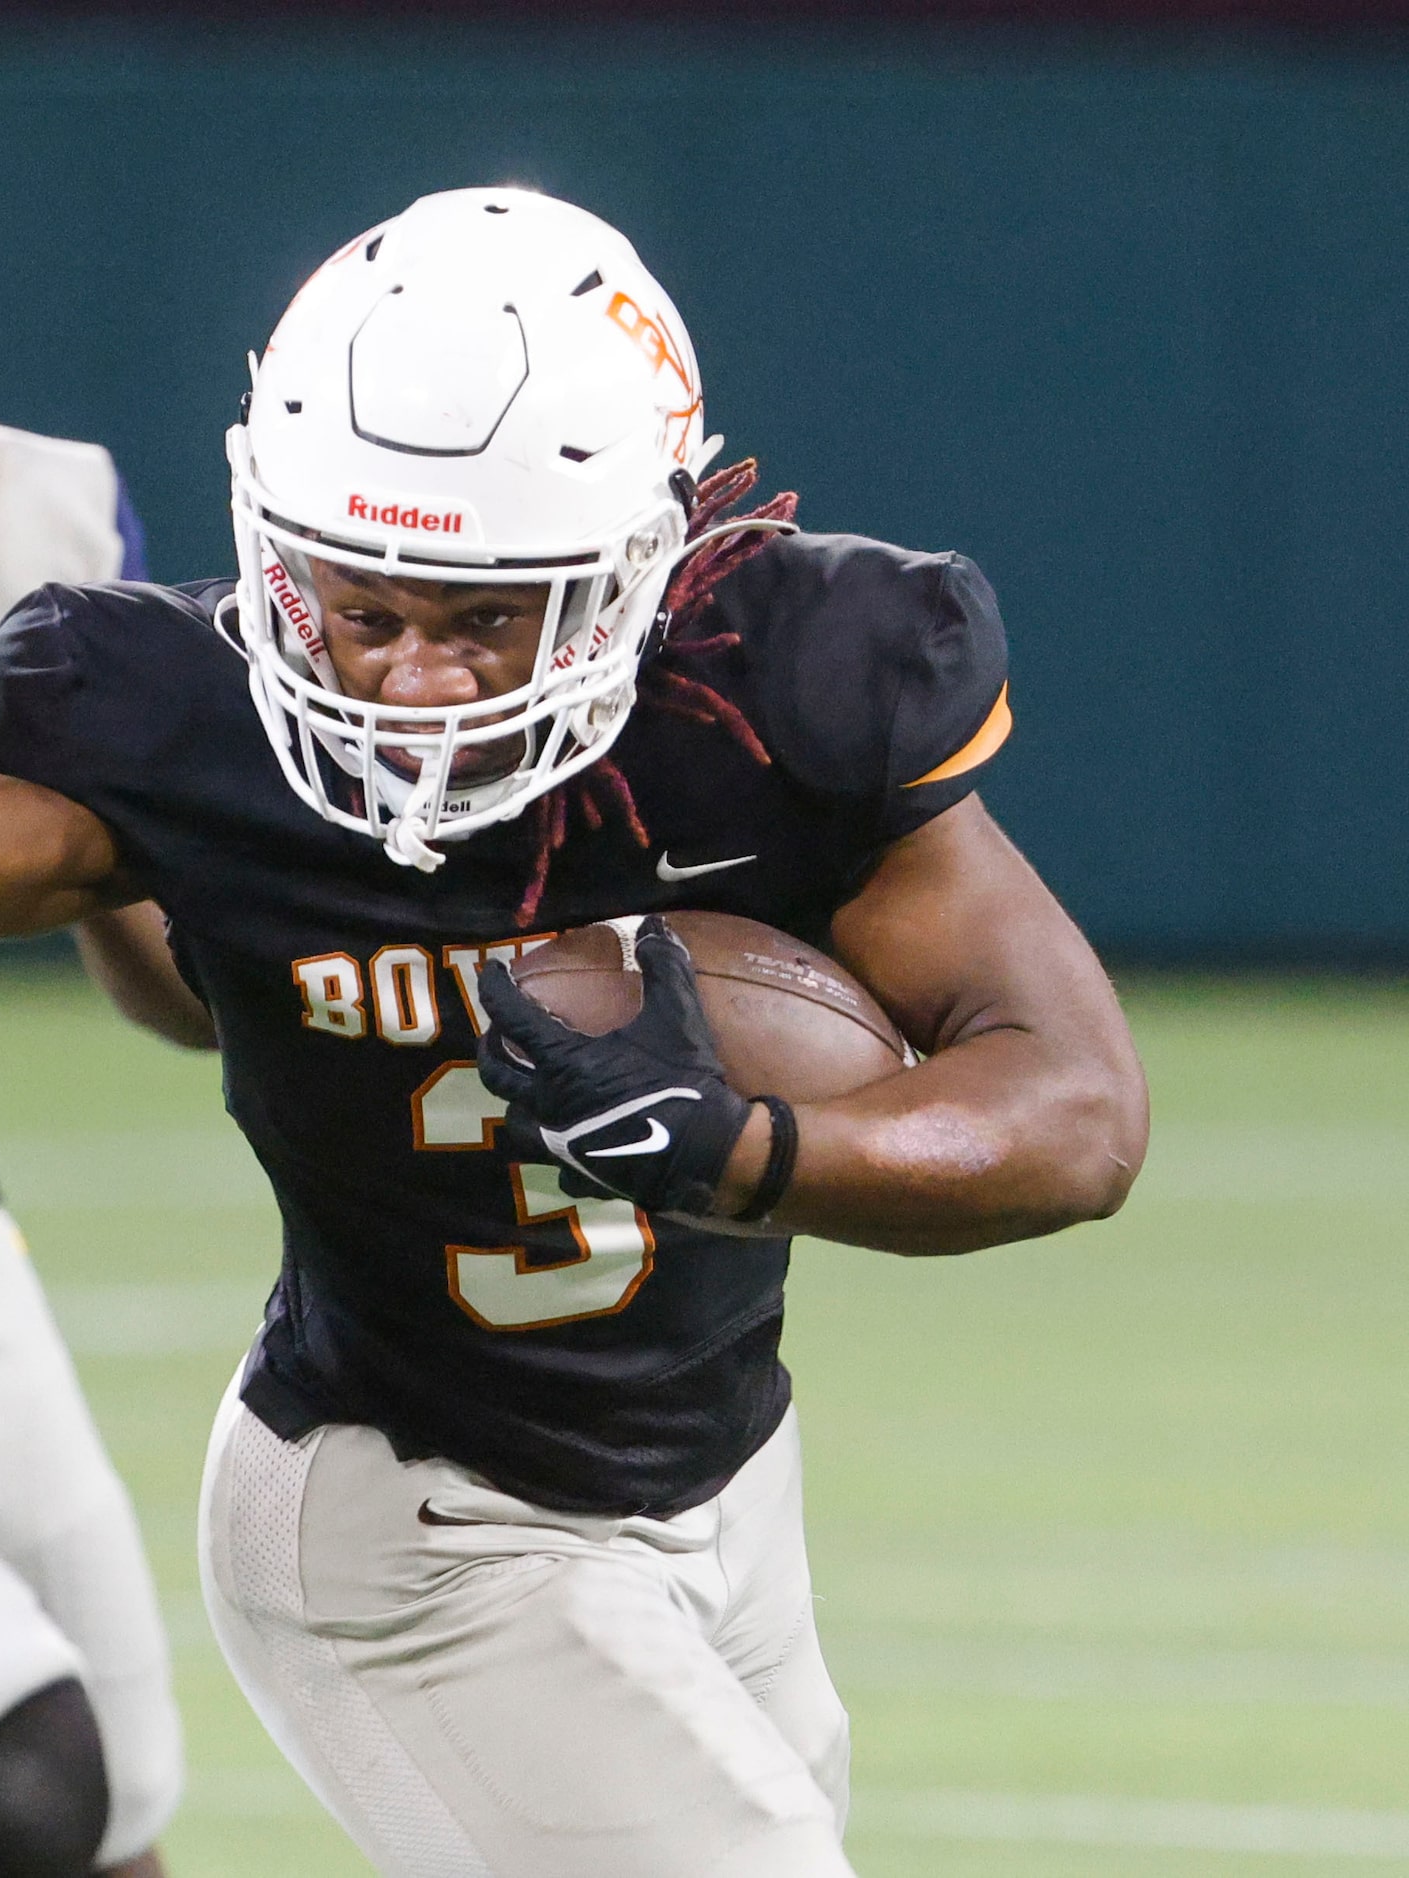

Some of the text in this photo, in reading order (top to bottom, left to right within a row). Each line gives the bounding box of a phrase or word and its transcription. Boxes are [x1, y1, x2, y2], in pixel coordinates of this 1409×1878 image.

[348, 494, 462, 534] Riddell
[263, 562, 326, 658] Riddell
[411, 1059, 655, 1333] 3
